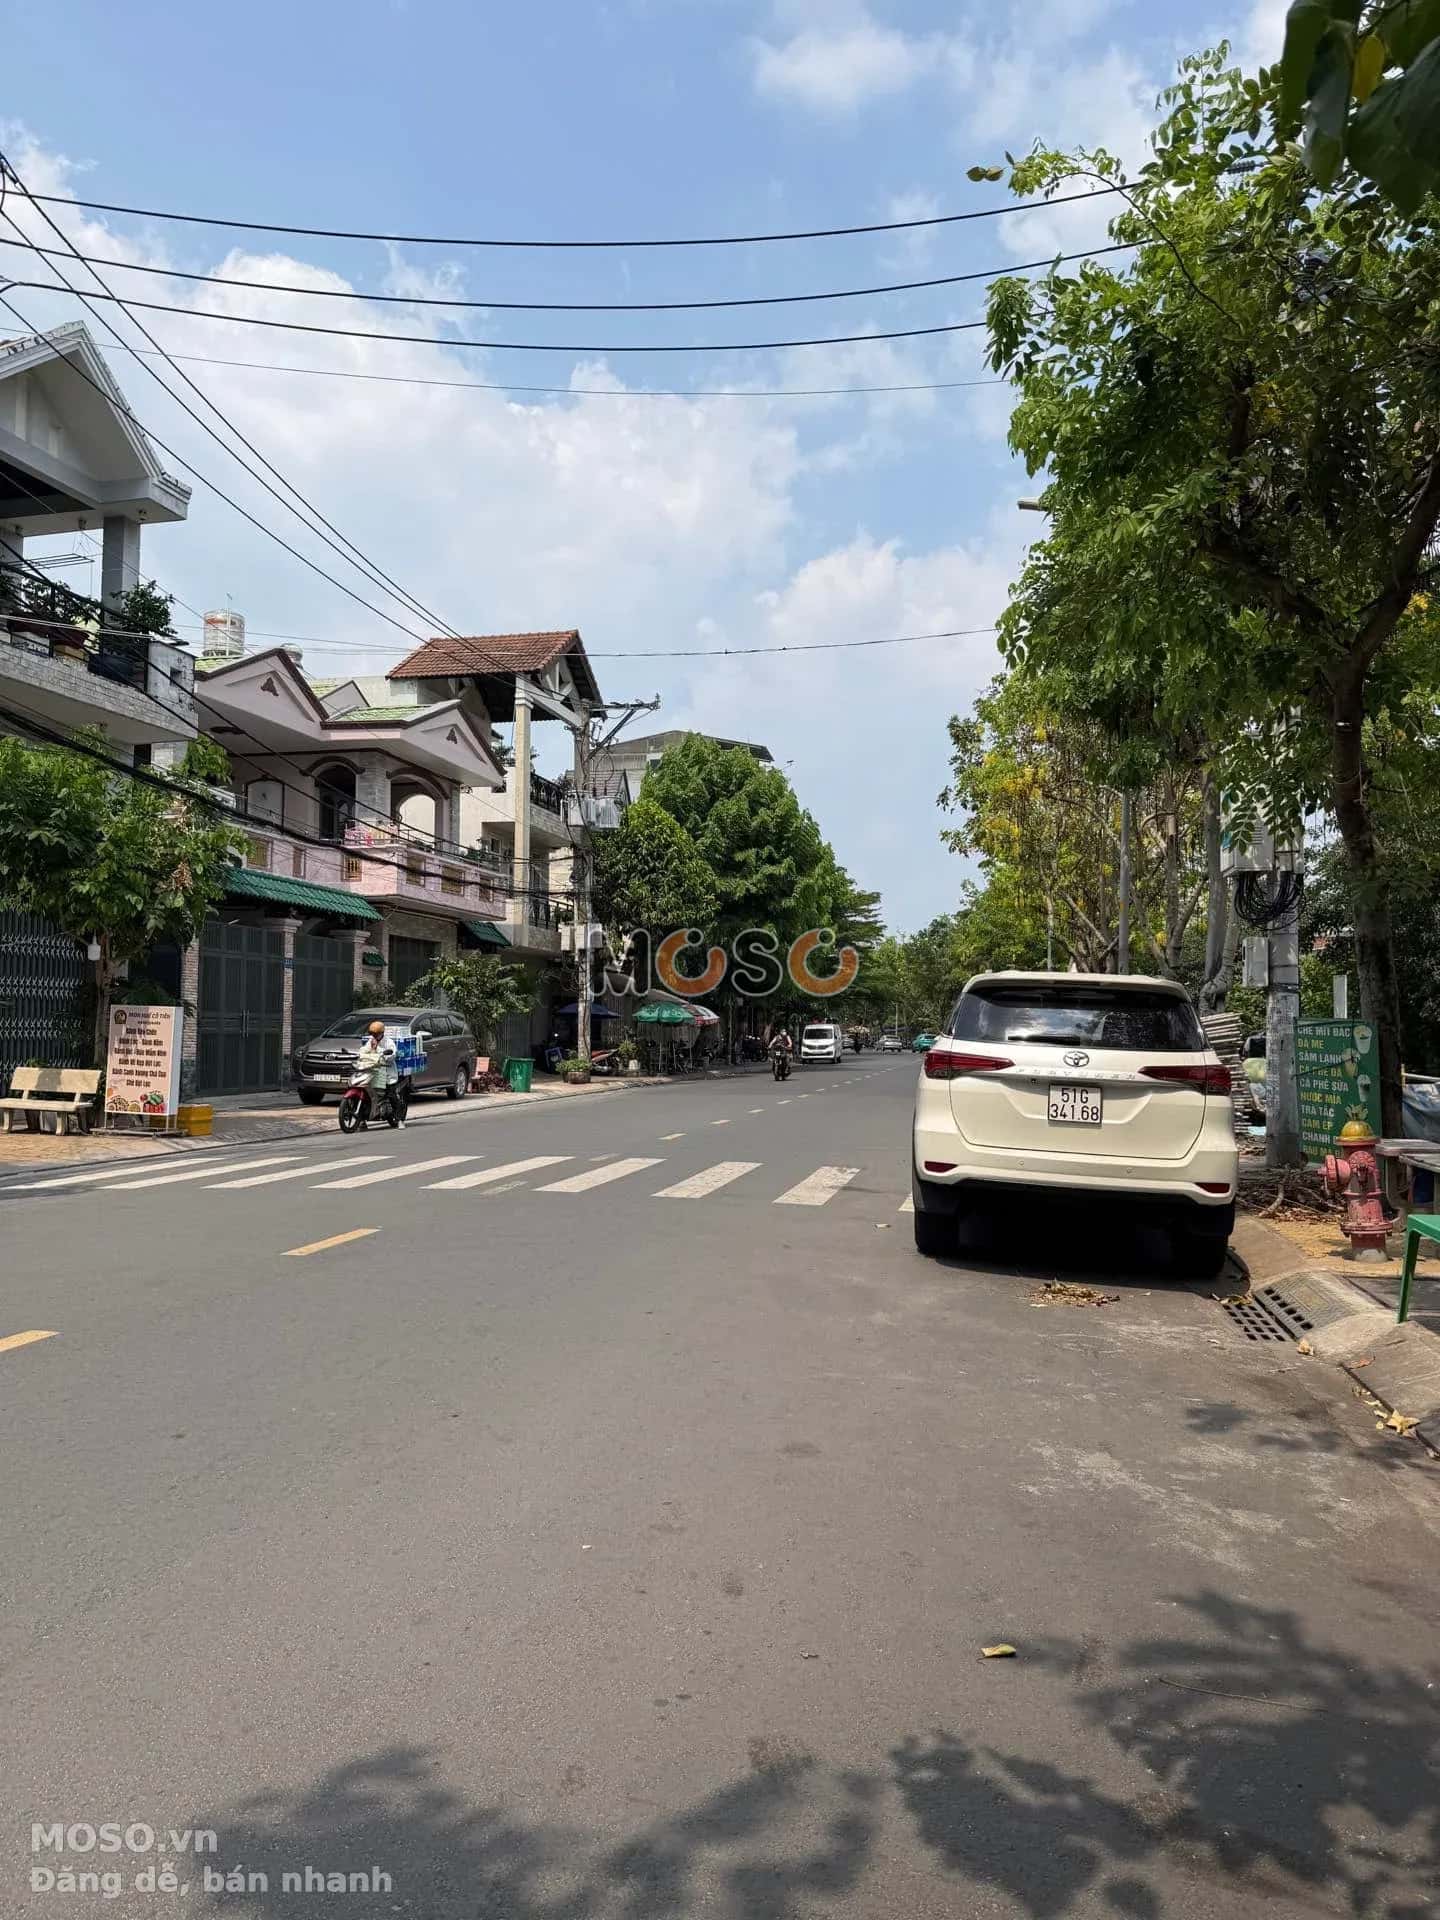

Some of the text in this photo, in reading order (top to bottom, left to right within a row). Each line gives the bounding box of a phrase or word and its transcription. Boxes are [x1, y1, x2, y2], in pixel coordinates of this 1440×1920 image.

[1061, 1087, 1089, 1104] 51G
[1050, 1104, 1099, 1121] 341.68
[1302, 1131, 1331, 1144] CHANH
